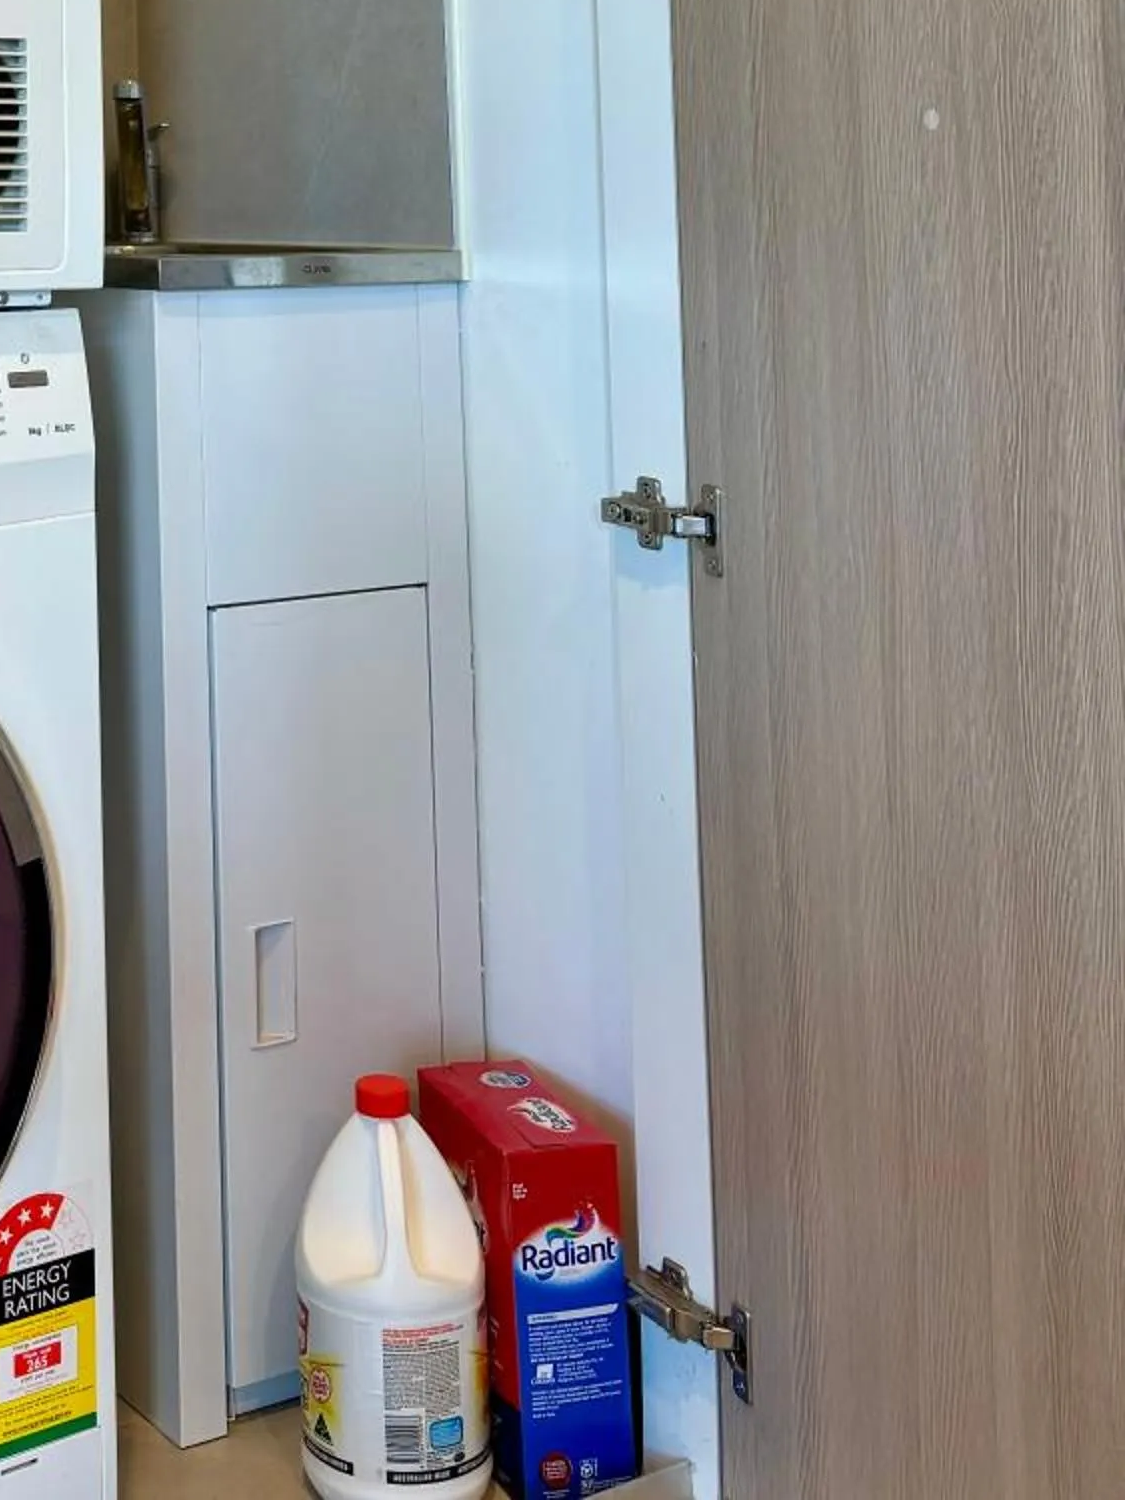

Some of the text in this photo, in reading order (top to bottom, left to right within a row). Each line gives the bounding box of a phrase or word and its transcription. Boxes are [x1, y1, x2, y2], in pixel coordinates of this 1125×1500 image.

[521, 1236, 617, 1271] Radiant
[2, 1259, 72, 1298] ENERGY
[4, 1283, 70, 1319] RATING
